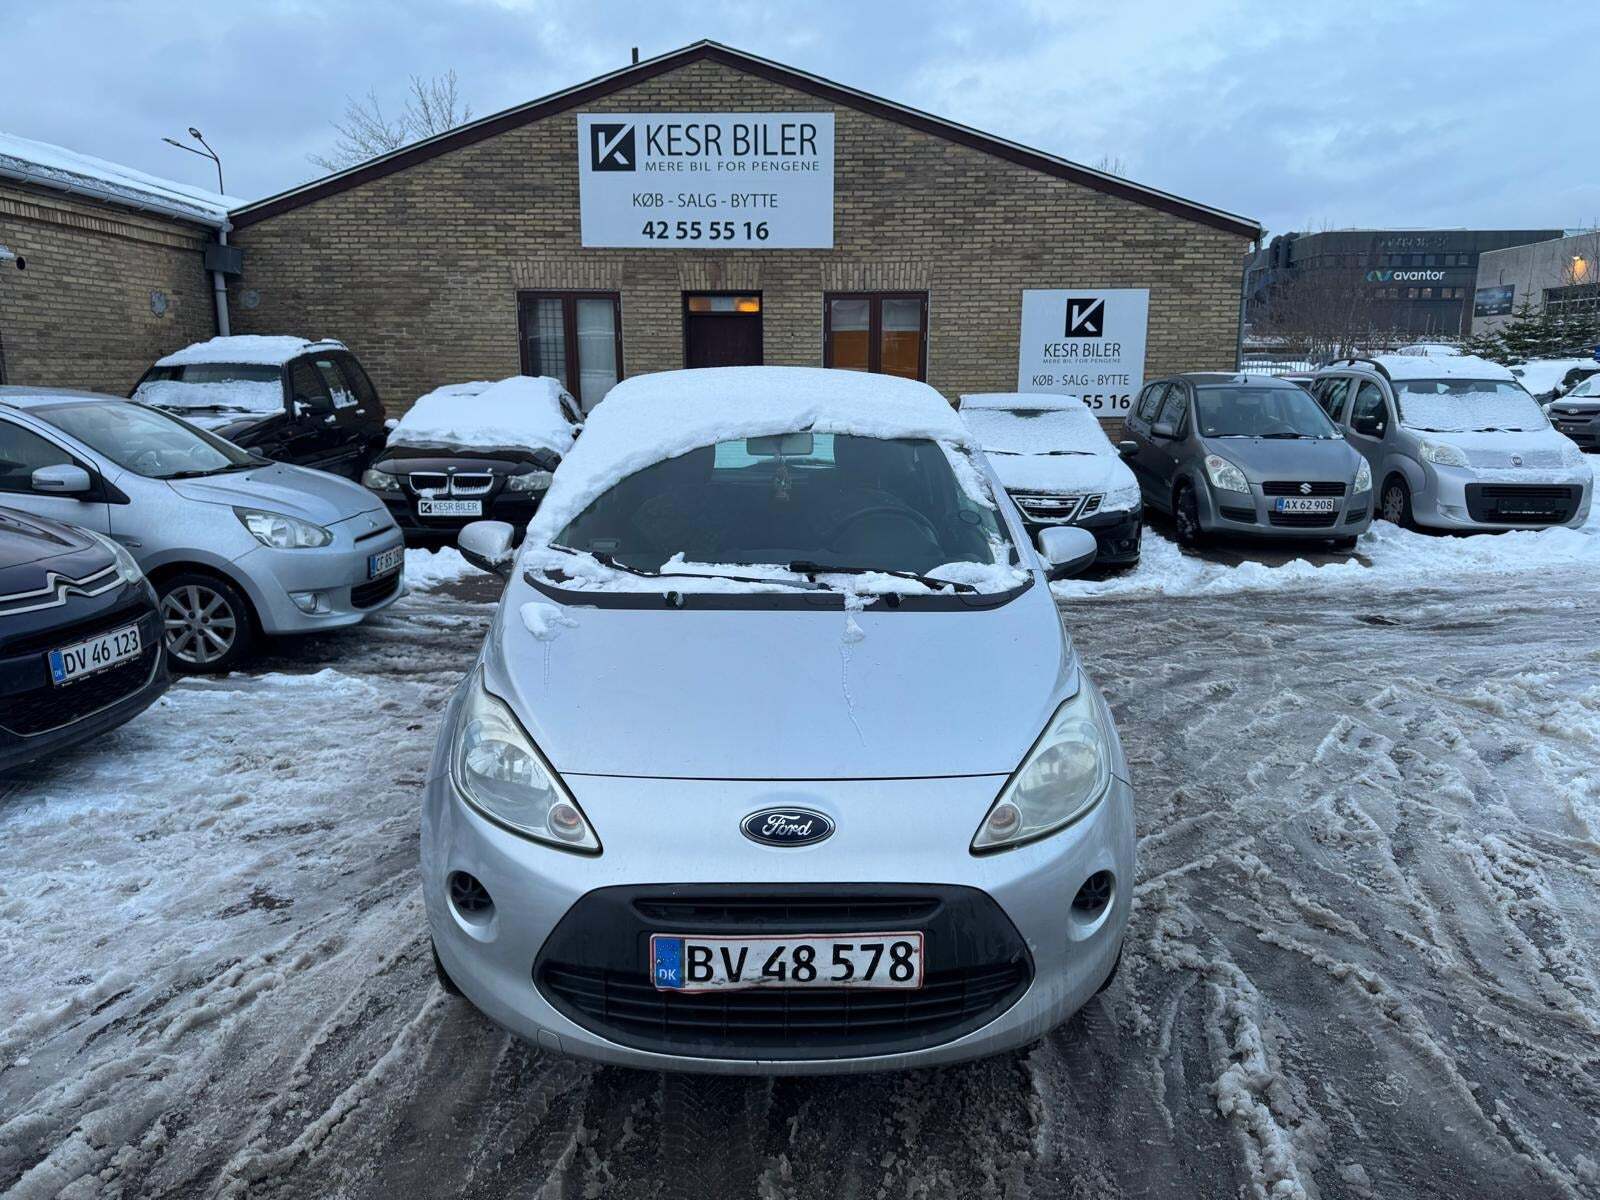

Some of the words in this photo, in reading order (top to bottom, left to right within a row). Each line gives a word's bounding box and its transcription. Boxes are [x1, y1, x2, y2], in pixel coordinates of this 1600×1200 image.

[646, 124, 722, 156] KESR
[733, 123, 818, 156] BILER
[645, 161, 684, 172] MERE
[690, 161, 711, 172] BIL
[717, 161, 746, 172] FOR
[752, 161, 820, 172] PENGENE
[632, 193, 664, 208] KØB
[677, 193, 717, 208] SALG
[731, 193, 778, 208] BYTTE
[642, 221, 669, 240] 42
[676, 221, 702, 240] 55
[709, 221, 735, 240] 55
[743, 221, 769, 240] 16
[1393, 270, 1446, 281] avantor
[1044, 343, 1078, 358] KESR
[1082, 343, 1121, 358] BILER
[1032, 375, 1054, 386] KØB
[1062, 374, 1088, 386] SALG
[1097, 374, 1130, 385] BYTTE
[1083, 394, 1104, 409] 55
[1109, 394, 1130, 409] 16
[434, 503, 454, 511] KESR
[455, 503, 477, 511] BILER
[1284, 501, 1297, 509] AX
[1300, 501, 1312, 510] 62
[1315, 501, 1332, 510] 908
[64, 648, 86, 674] DV
[92, 640, 110, 663] 46
[114, 630, 139, 656] 123
[761, 814, 812, 837] Ford
[687, 945, 748, 983] BV
[761, 945, 817, 982] 48
[831, 941, 915, 982] 578
[659, 969, 676, 980] DK
